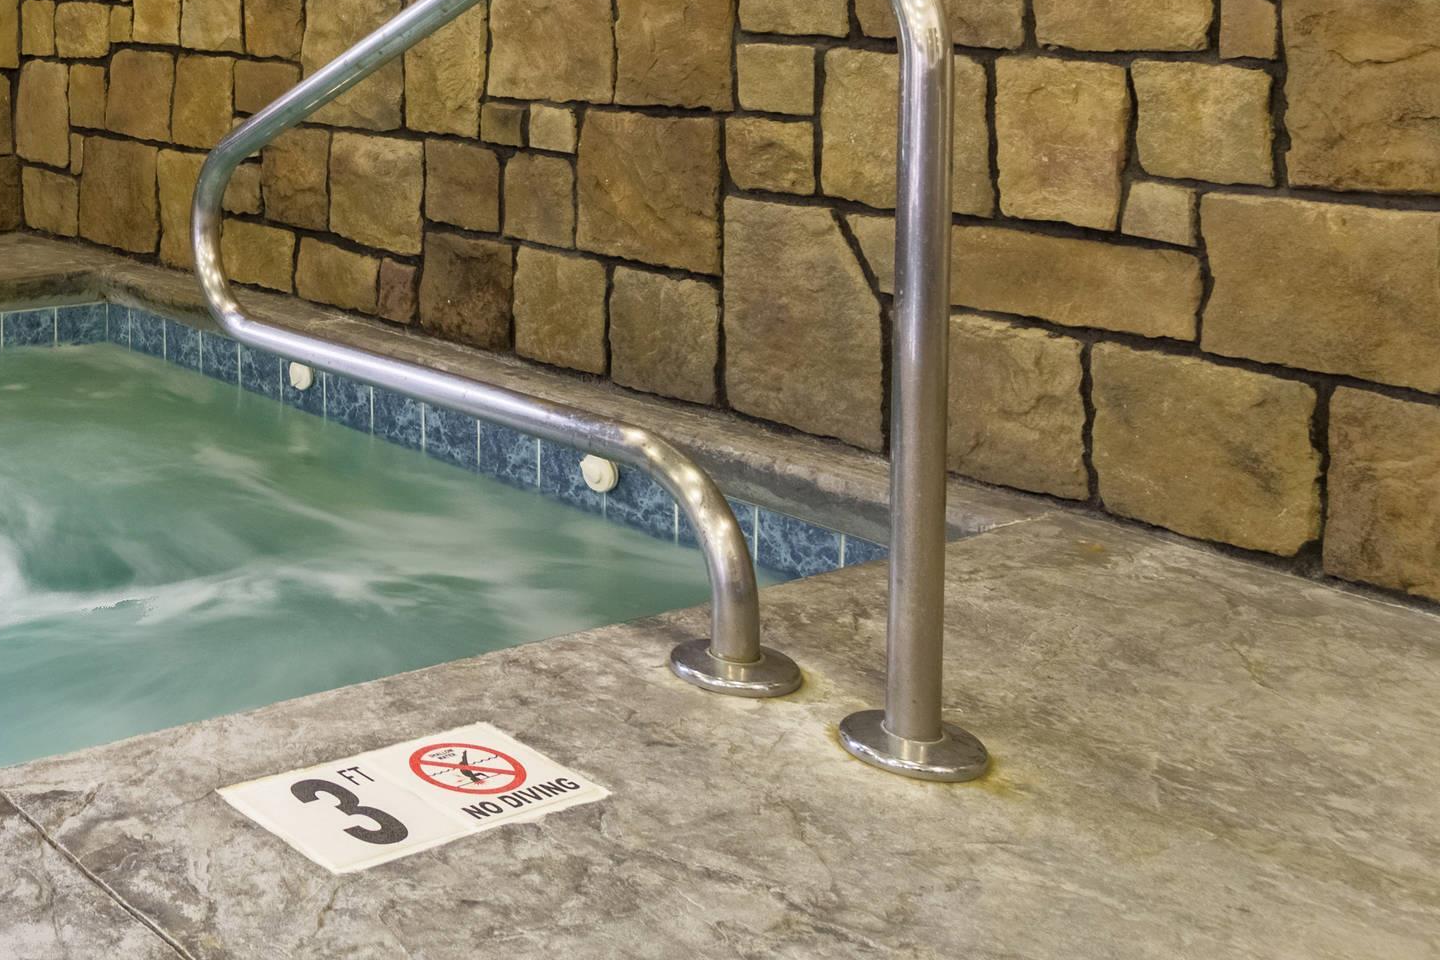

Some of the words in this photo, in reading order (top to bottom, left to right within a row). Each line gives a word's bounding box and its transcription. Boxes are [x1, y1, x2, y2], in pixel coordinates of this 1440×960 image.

[337, 766, 375, 787] FT
[291, 779, 409, 845] 3
[462, 793, 505, 820] NO
[506, 777, 580, 809] DIVING
